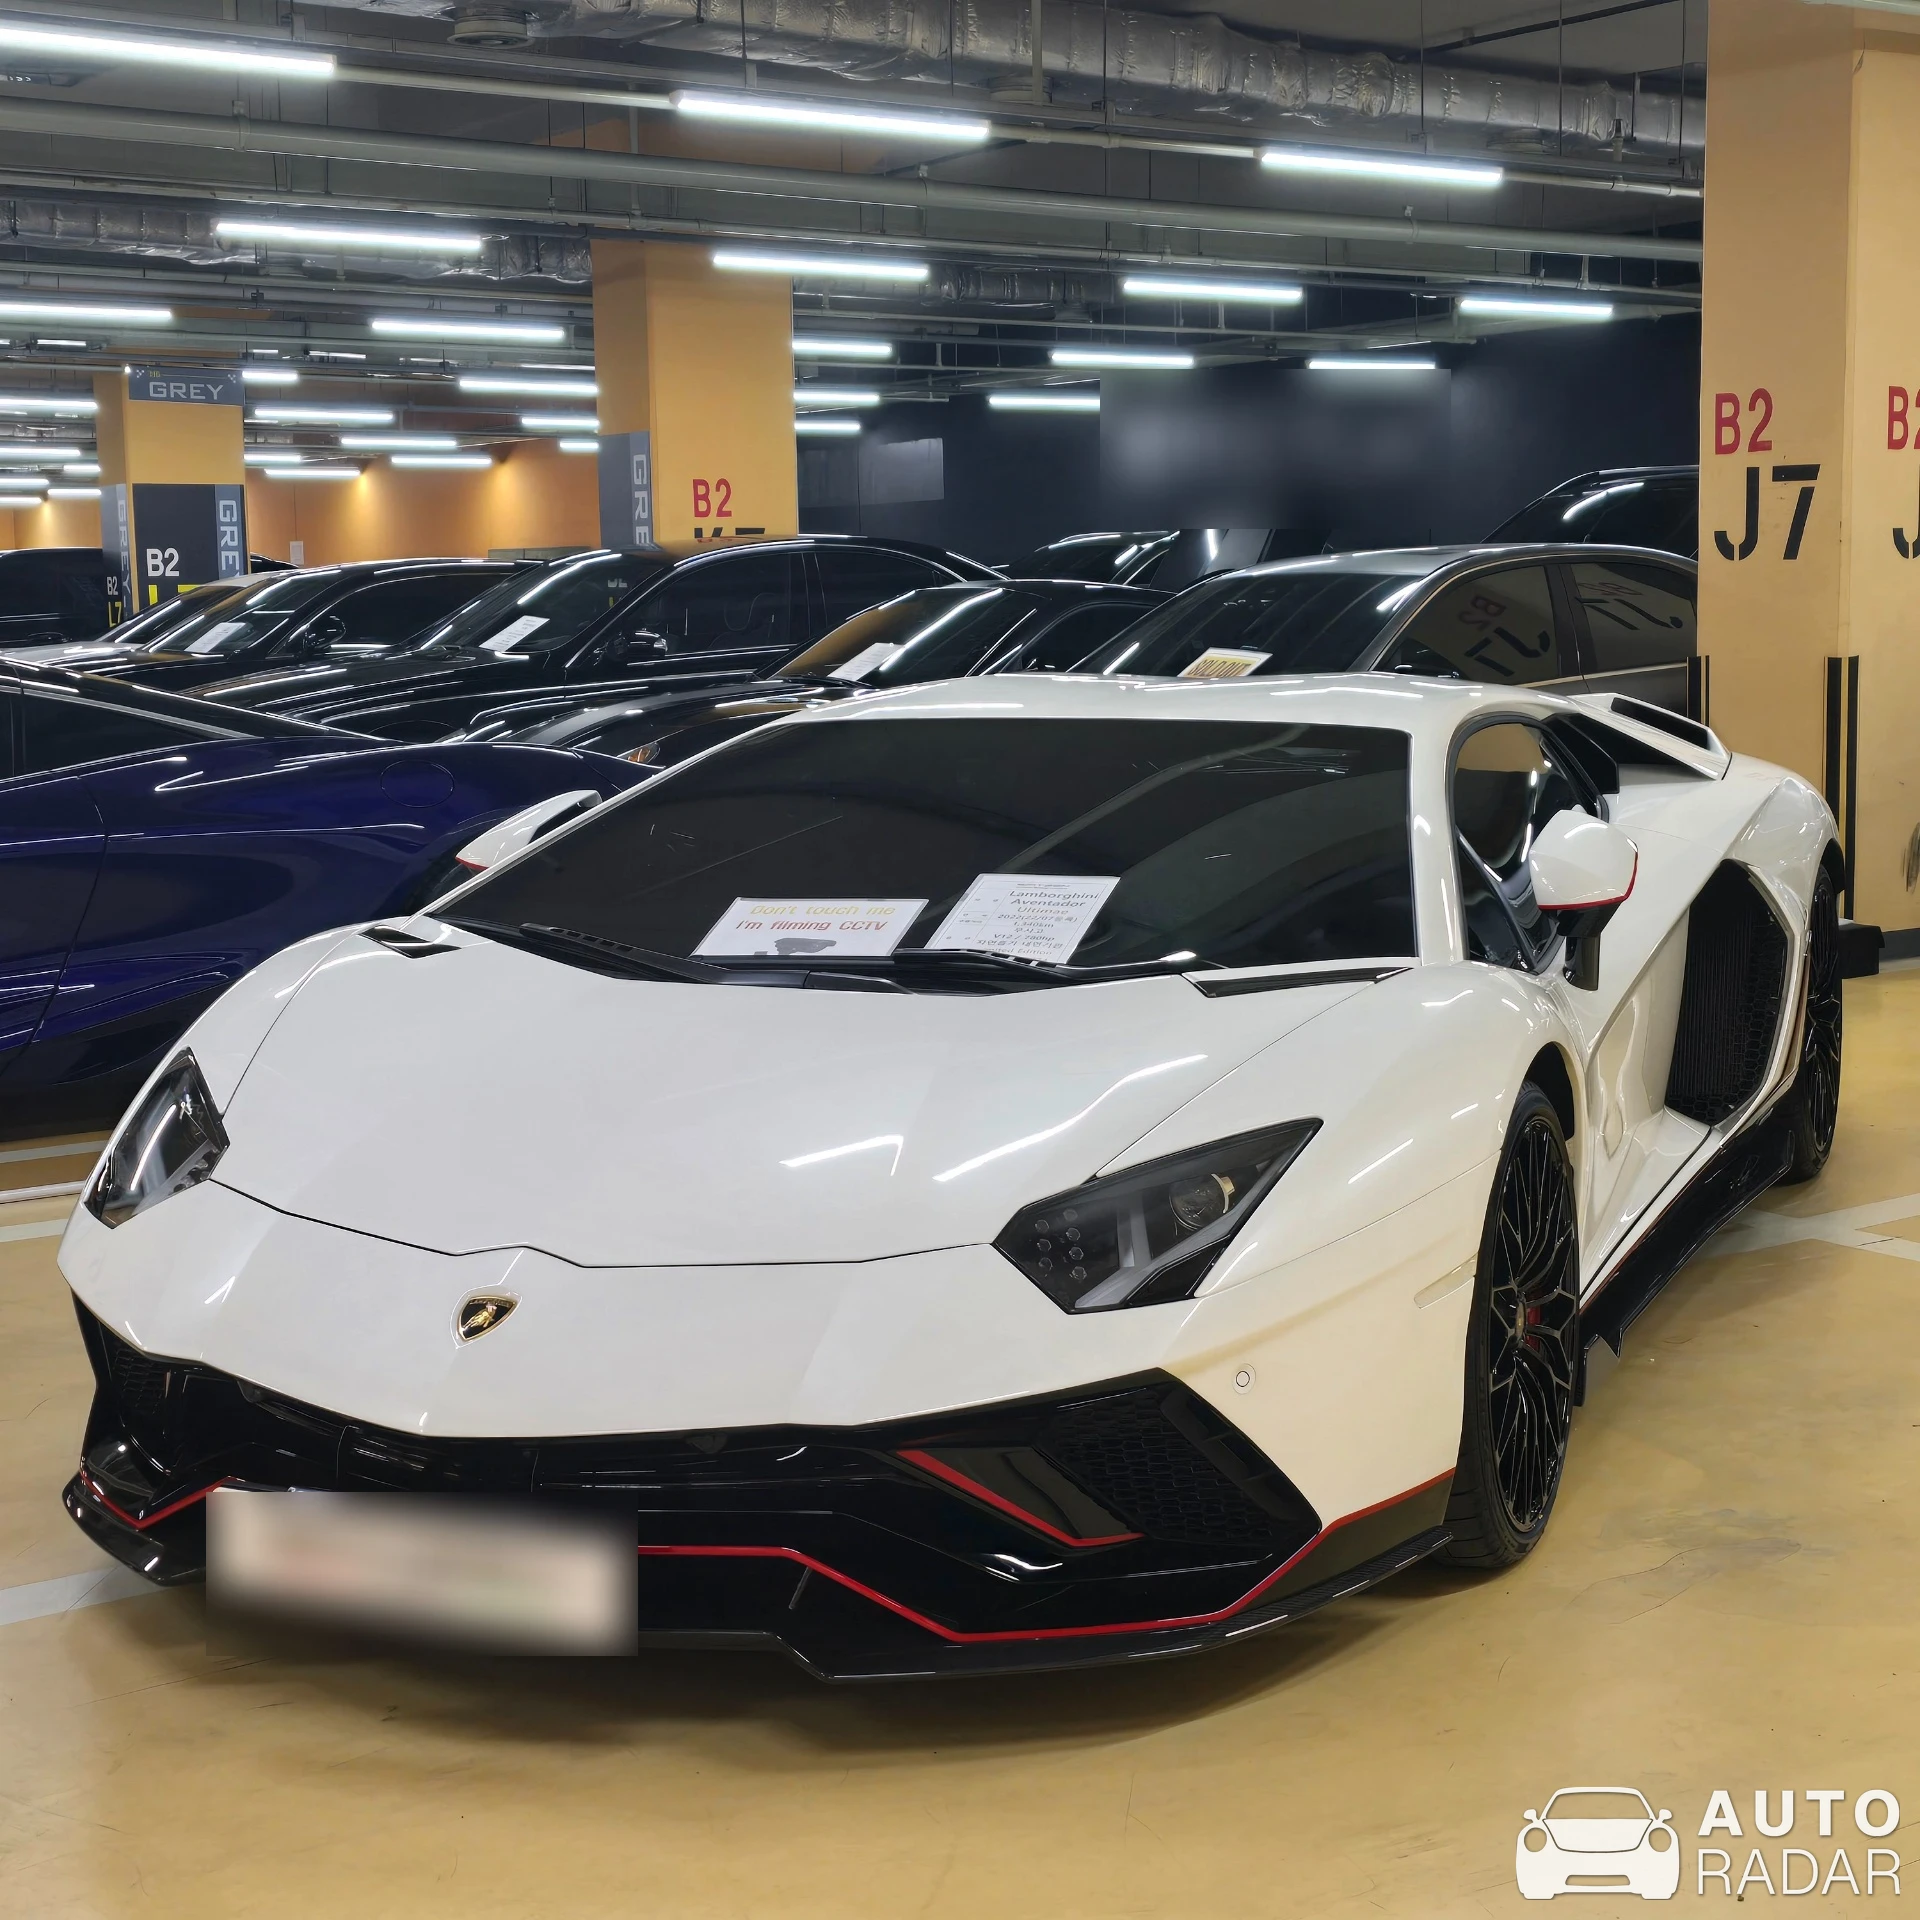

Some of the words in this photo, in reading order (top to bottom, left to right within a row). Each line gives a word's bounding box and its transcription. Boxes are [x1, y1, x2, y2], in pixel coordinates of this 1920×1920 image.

[149, 382, 223, 400] GREY
[1715, 388, 1773, 455] B2
[1887, 385, 1920, 450] B
[633, 454, 650, 545] GRE
[692, 478, 732, 518] B2
[1714, 464, 1821, 560] J7
[117, 500, 131, 594] GREY
[219, 500, 240, 577] GRE
[146, 547, 180, 577] B2
[106, 576, 118, 595] B2
[108, 602, 122, 628] L7
[750, 905, 797, 915] Don't
[806, 905, 859, 915] touch
[864, 906, 895, 915] me
[1009, 890, 1099, 900] Lamborghini
[1011, 898, 1086, 907] Aventador
[735, 920, 763, 930] I'm
[770, 920, 831, 931] filming
[839, 920, 888, 931] CCTV
